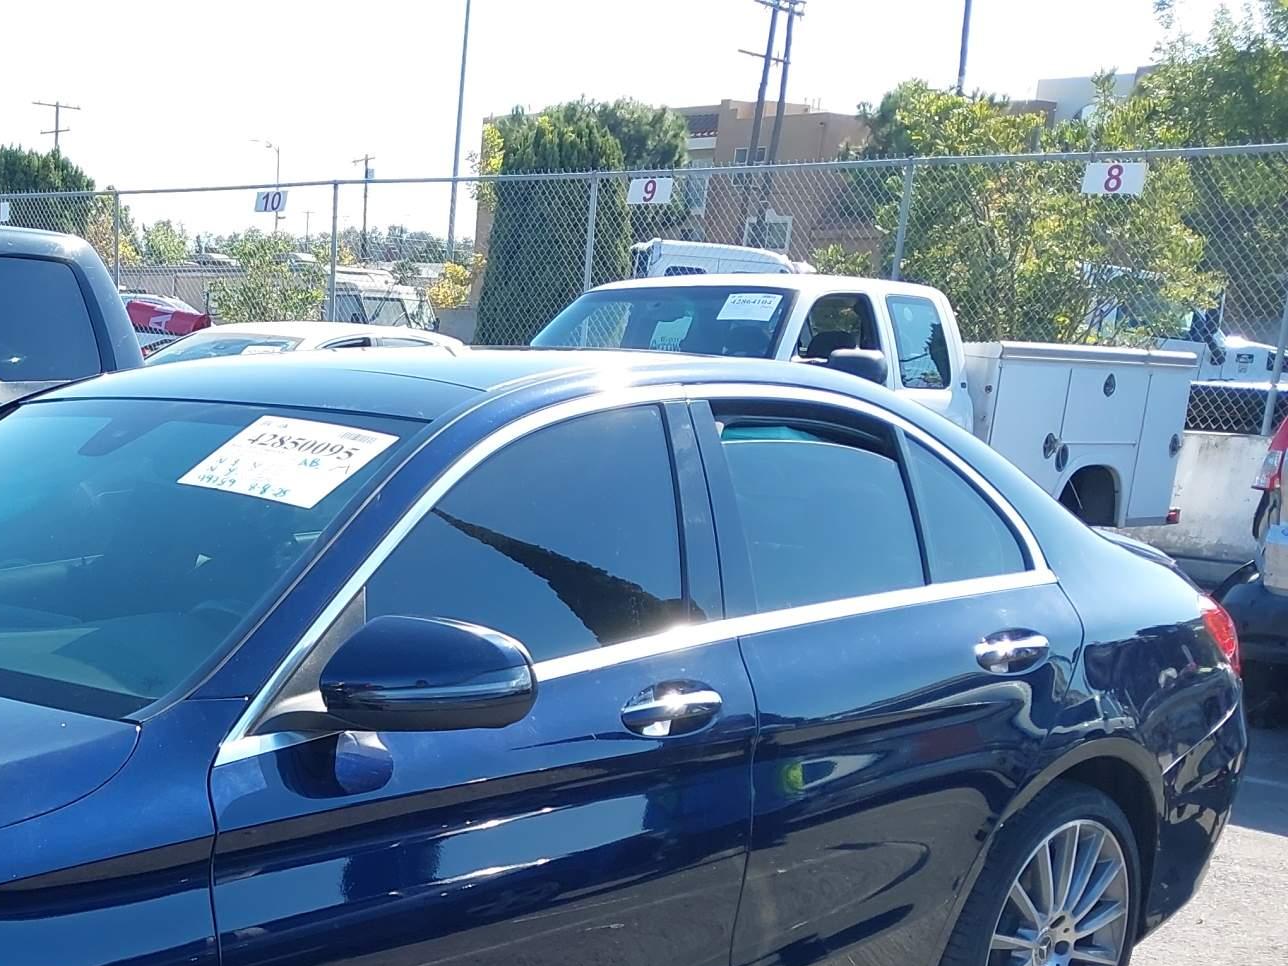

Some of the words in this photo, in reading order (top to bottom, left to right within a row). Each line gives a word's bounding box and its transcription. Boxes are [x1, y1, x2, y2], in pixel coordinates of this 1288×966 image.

[642, 179, 657, 203] 9
[1104, 164, 1124, 193] 8
[262, 191, 282, 211] 10
[247, 432, 361, 461] 42850095
